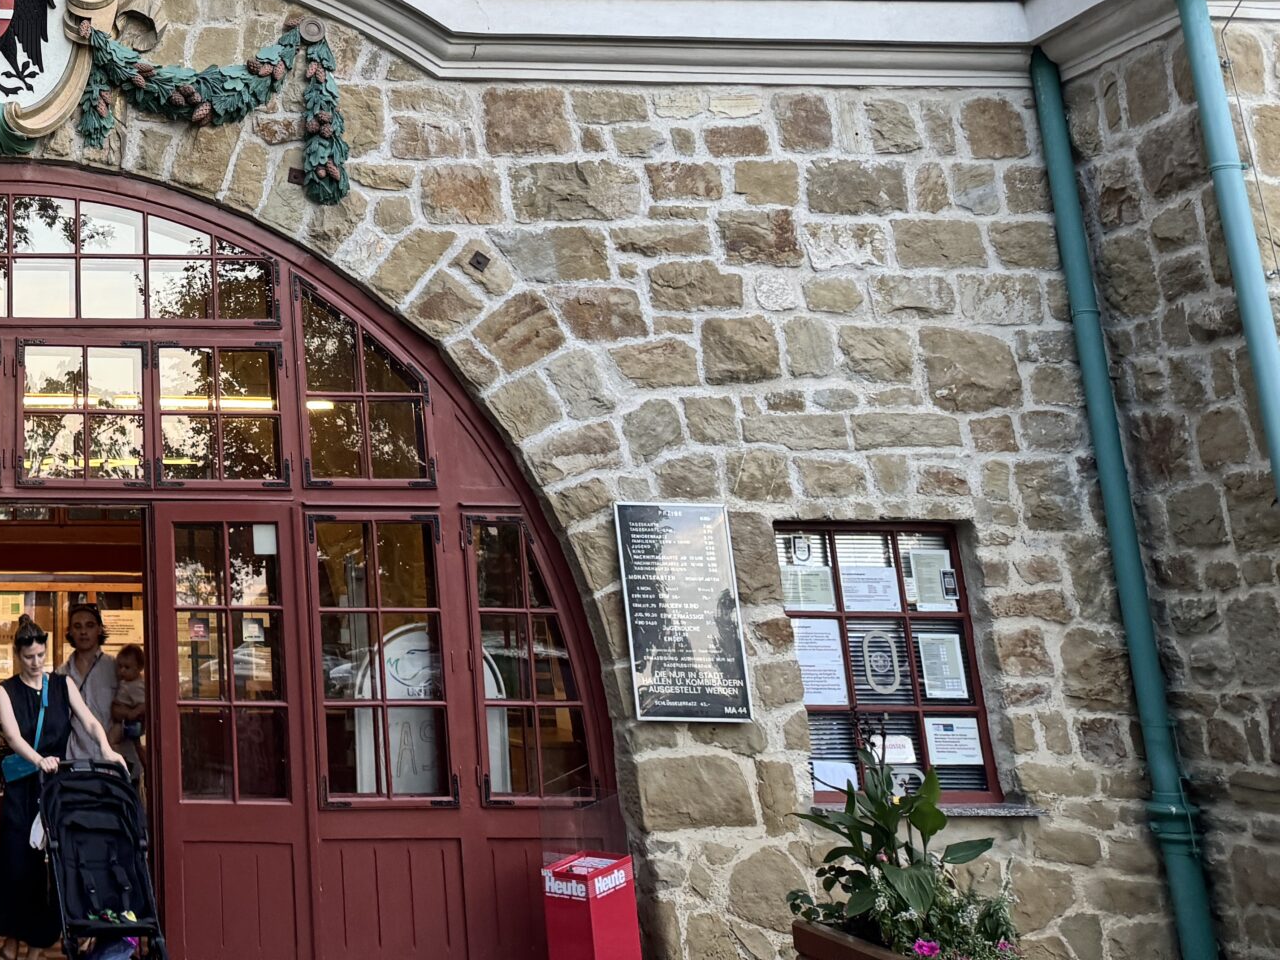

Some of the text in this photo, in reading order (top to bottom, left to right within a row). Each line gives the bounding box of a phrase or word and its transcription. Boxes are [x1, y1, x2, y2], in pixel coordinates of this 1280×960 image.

[654, 670, 667, 678] DIE
[669, 671, 686, 679] NUR
[687, 671, 697, 679] IN
[648, 685, 738, 695] AUSGESTELLT WERDEN
[724, 706, 747, 714] MA 44
[545, 875, 586, 897] Heute
[594, 868, 626, 895] Heute
